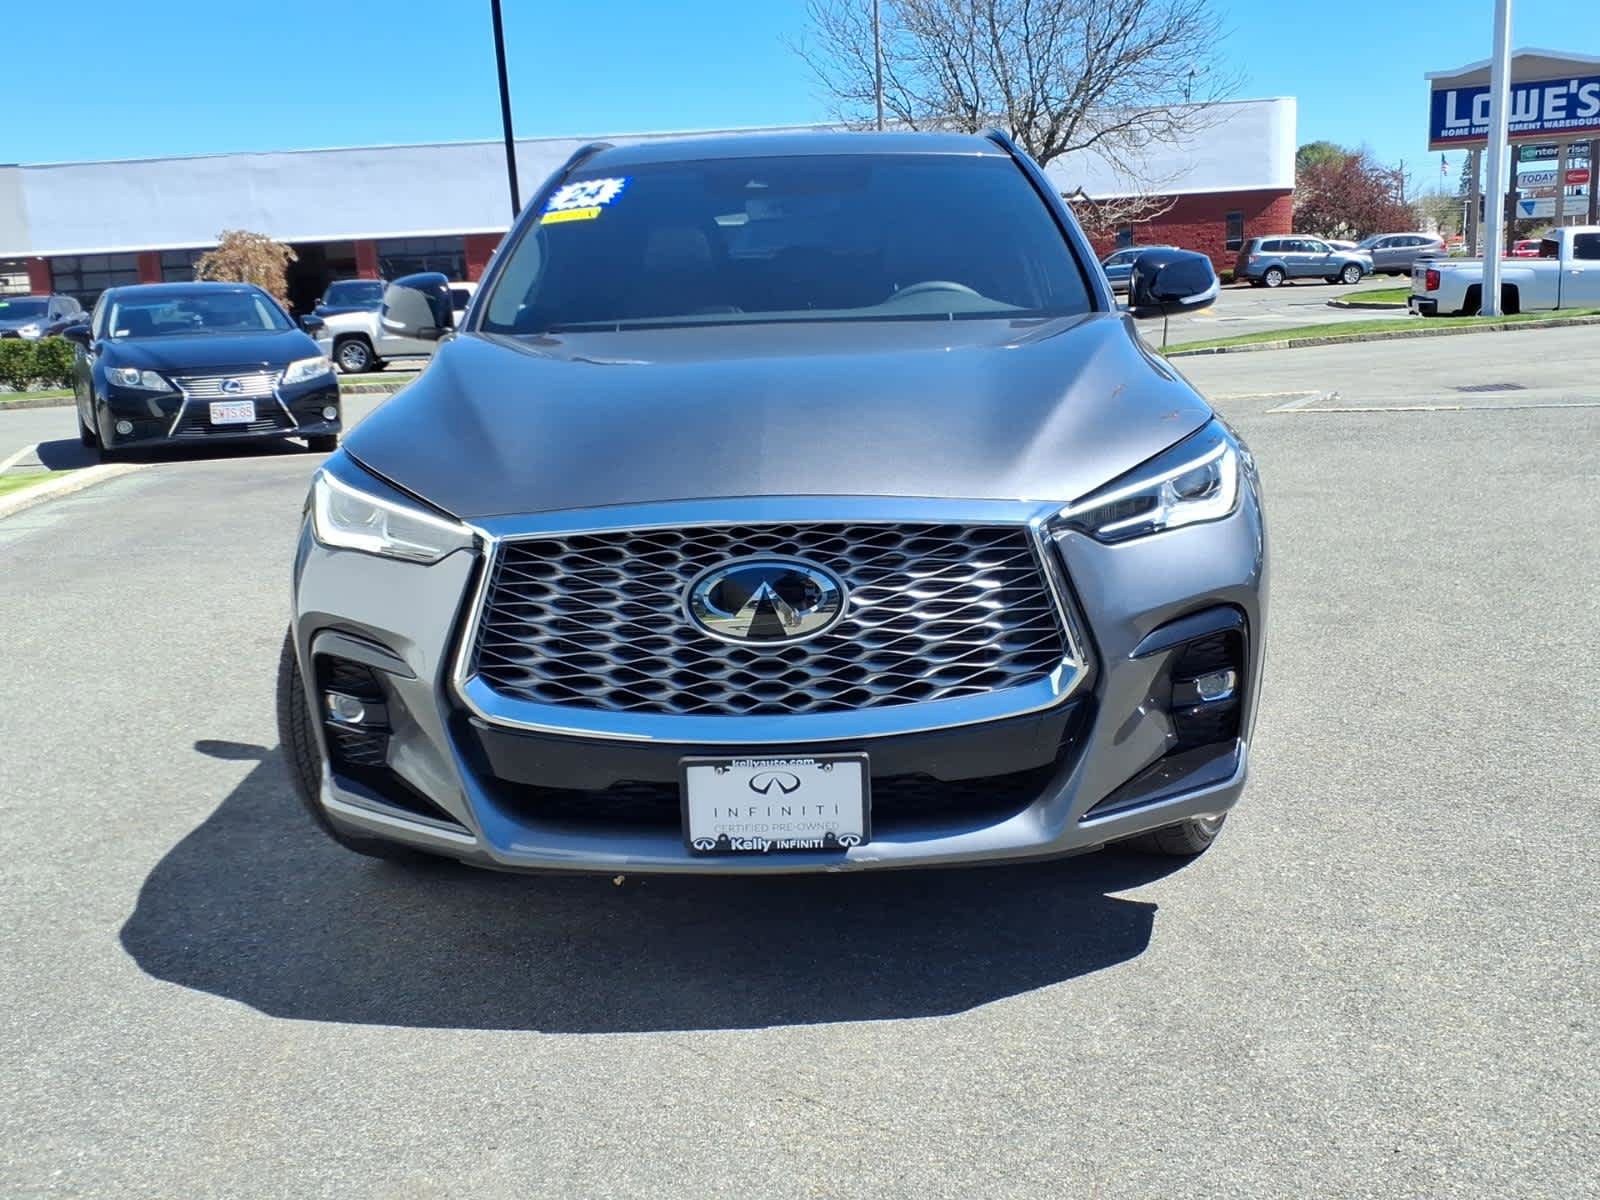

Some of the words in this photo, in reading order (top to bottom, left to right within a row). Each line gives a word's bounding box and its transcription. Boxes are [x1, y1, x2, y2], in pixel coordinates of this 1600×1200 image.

[1441, 127, 1469, 137] HOME
[1522, 172, 1554, 183] TODAY
[714, 805, 839, 817] INFINITI
[714, 823, 769, 834] CERTIFIED
[772, 821, 840, 832] PRE-OWNED
[731, 838, 771, 852] Kelly
[777, 839, 824, 849] INFINITI
